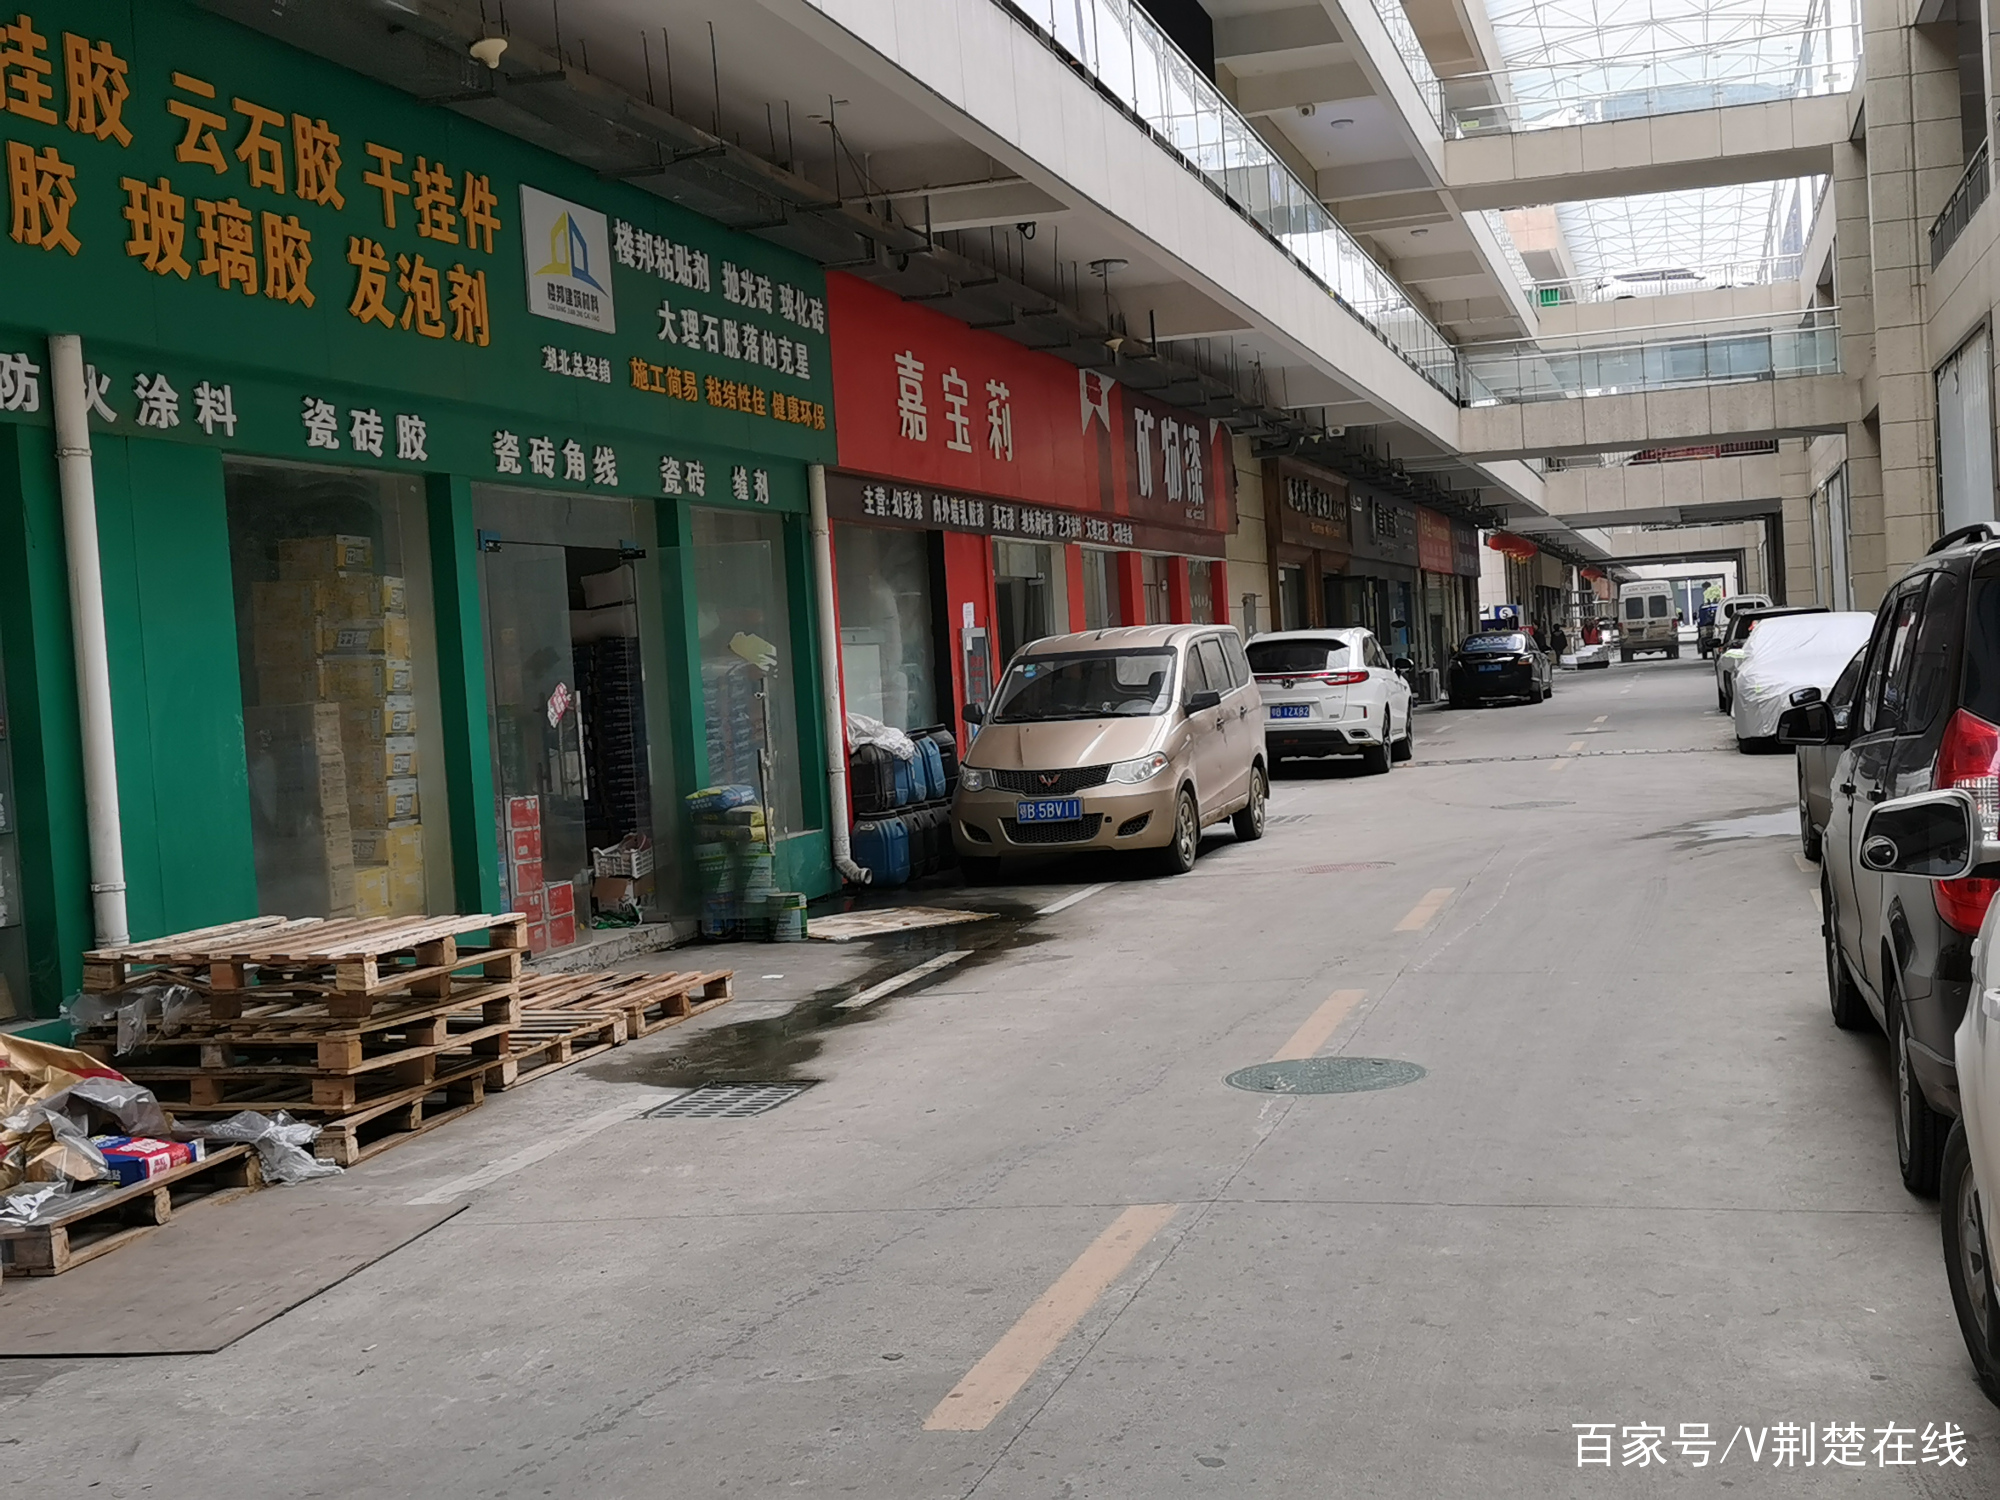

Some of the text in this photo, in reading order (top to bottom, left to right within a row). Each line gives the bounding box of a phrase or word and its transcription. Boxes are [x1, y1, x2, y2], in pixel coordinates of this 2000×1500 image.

[166, 71, 345, 211] 云石胶
[363, 142, 501, 254] 干挂件
[6, 140, 490, 347] 胶 玻璃胶 发泡剂
[612, 218, 825, 334] 楼邦粘贴剂 抛光砖 玻化砖
[542, 345, 611, 383] 湖北总经销
[657, 301, 810, 380] 大理石脱落的克星
[628, 357, 826, 430] 施工简易 粘结性佳 健康环保
[894, 350, 1013, 461] 嘉宝莉
[302, 397, 428, 461] 瓷砖胶
[494, 430, 618, 487] 瓷砖角线
[659, 456, 705, 497] 瓷砖
[1134, 407, 1204, 506] 矿物漆
